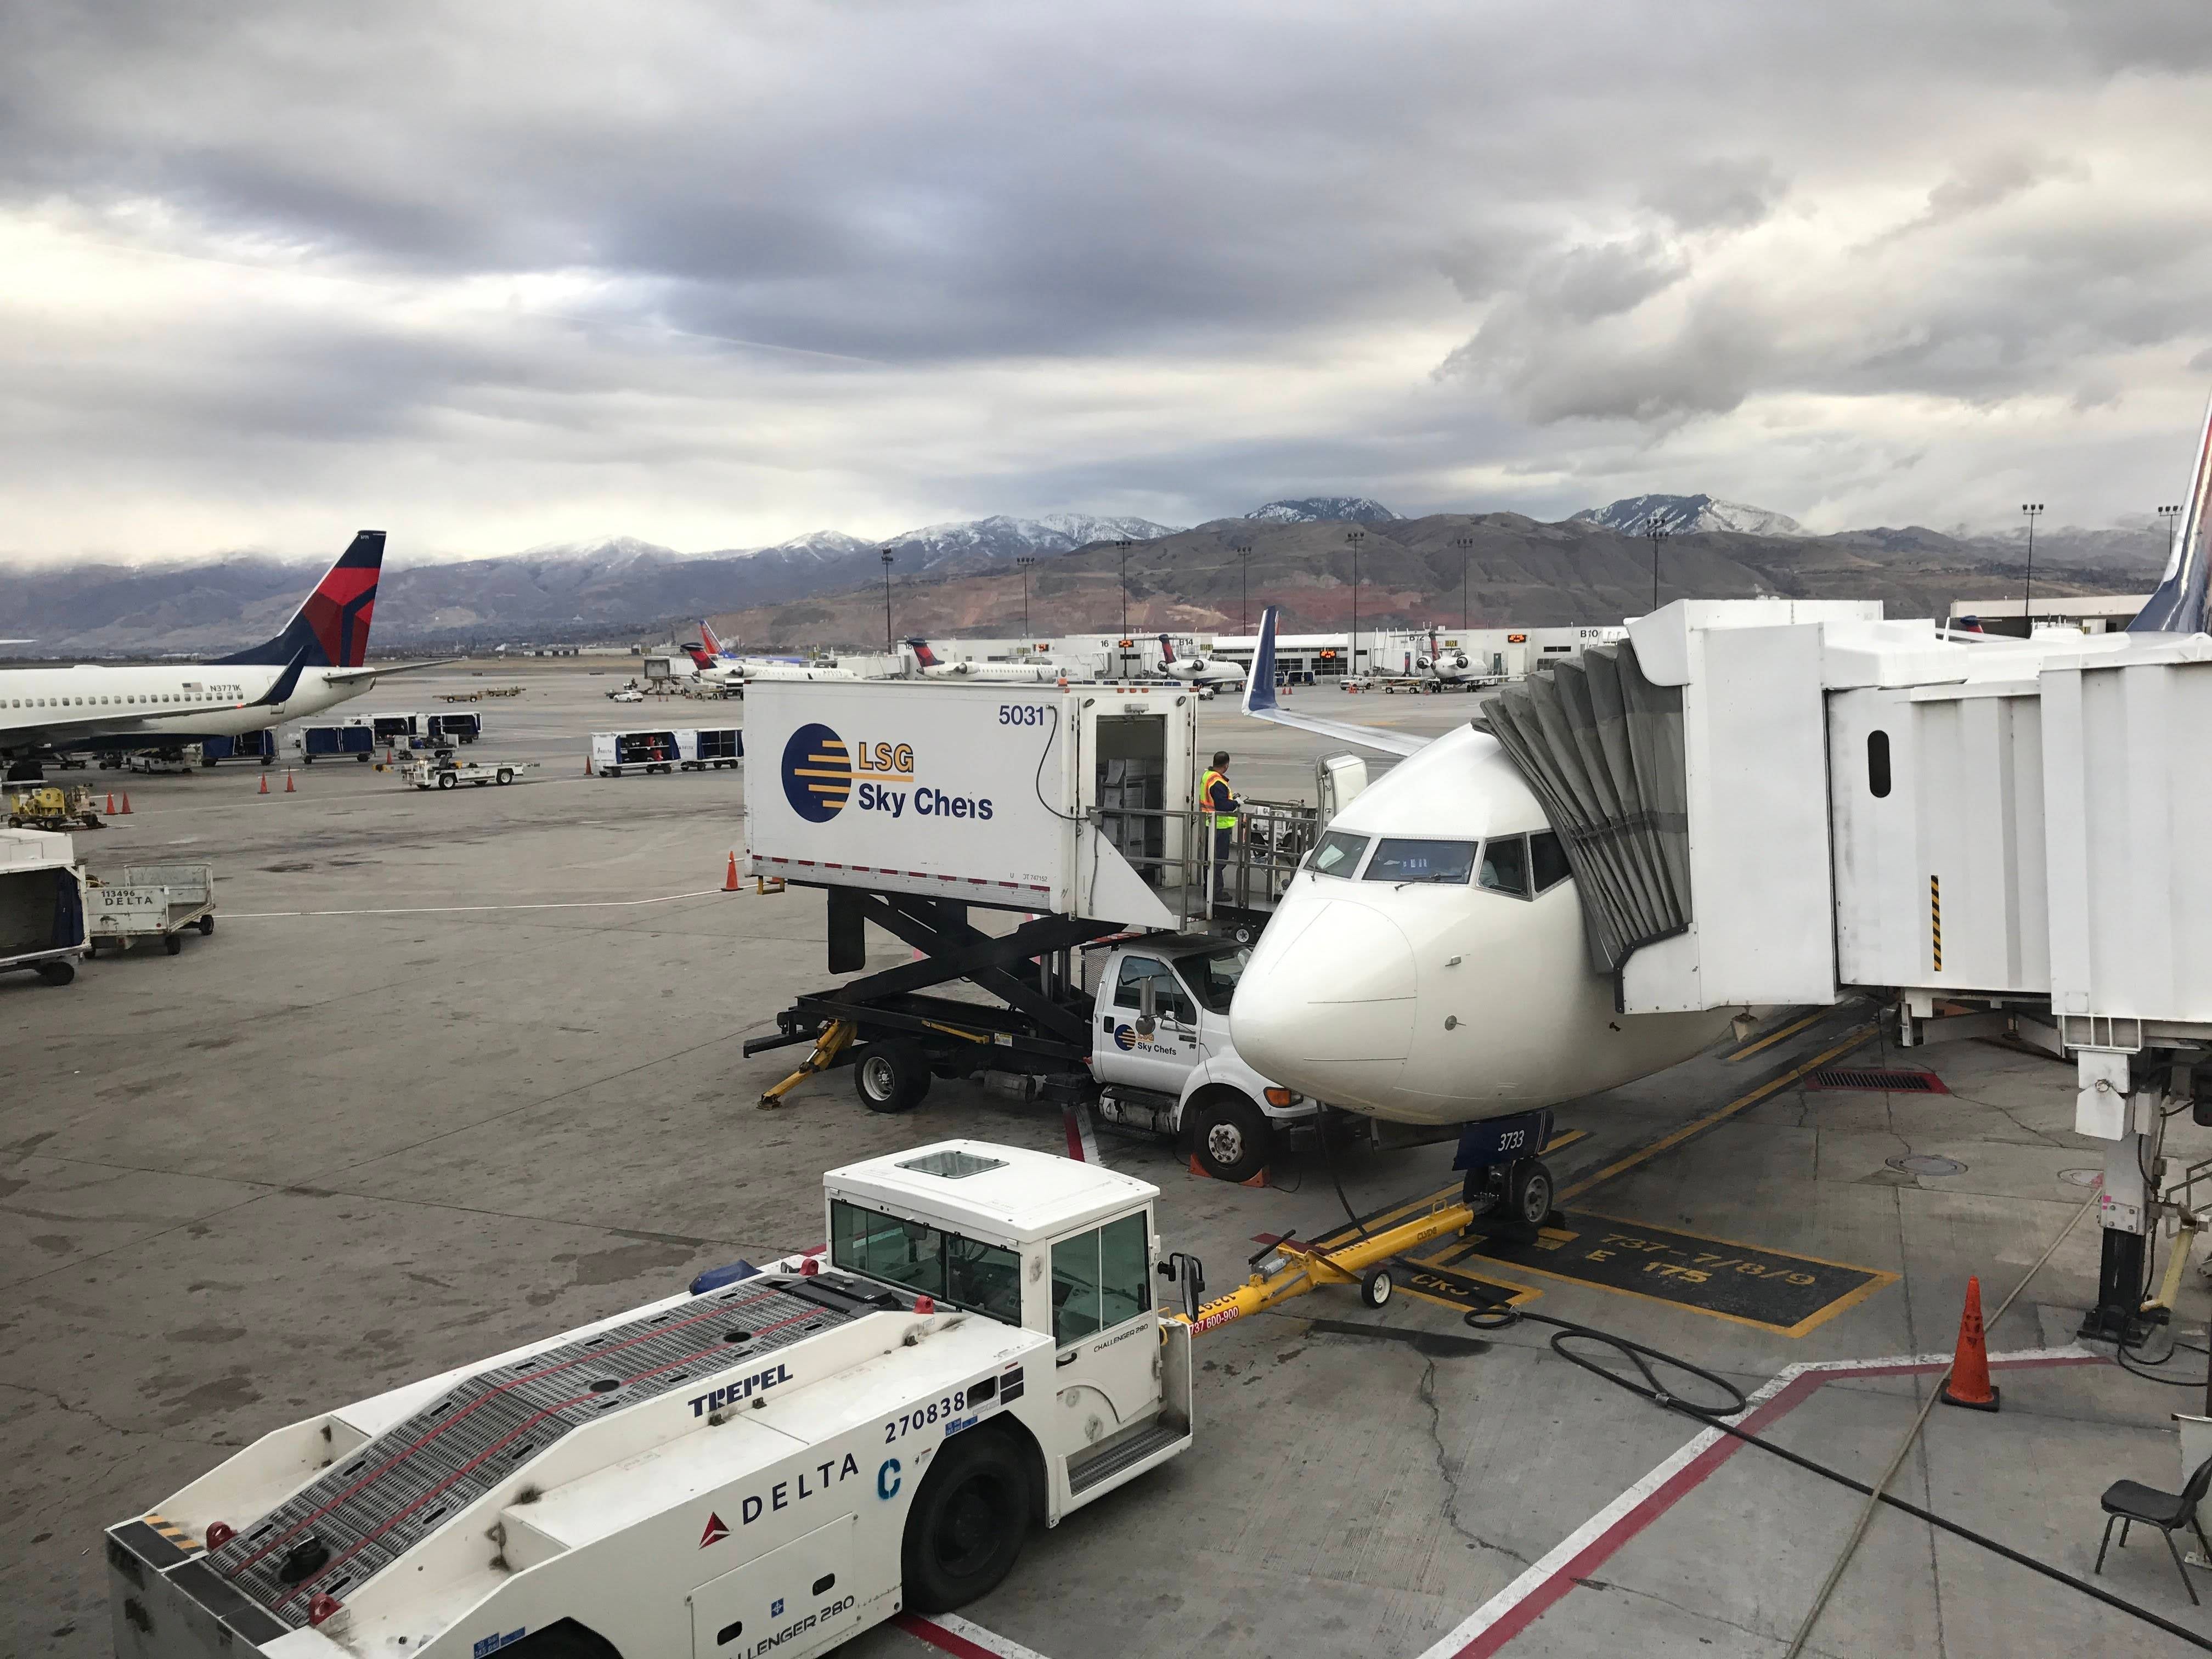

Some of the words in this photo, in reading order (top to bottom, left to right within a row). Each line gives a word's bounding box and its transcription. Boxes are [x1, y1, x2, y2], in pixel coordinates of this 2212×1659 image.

[1580, 629, 1598, 637] B10
[998, 705, 1043, 726] 5031
[859, 741, 914, 773] LSG
[858, 783, 906, 818] Sky
[105, 896, 154, 906] DELTA
[1137, 1042, 1152, 1052] Sky
[1154, 1045, 1177, 1056] Chefs
[1498, 1130, 1525, 1152] 3733
[1585, 1249, 1617, 1262] E
[1643, 1261, 1713, 1283] 175
[1189, 1320, 1205, 1335] 737
[1206, 1306, 1239, 1329] 600-900
[1093, 1329, 1135, 1353] CHALLENGER
[1136, 1323, 1149, 1334] 280
[687, 1363, 794, 1418] TREPEL
[885, 1391, 965, 1444] 270838
[742, 1453, 859, 1526] DELTA
[878, 1458, 901, 1500] C
[820, 1594, 855, 1623] 280
